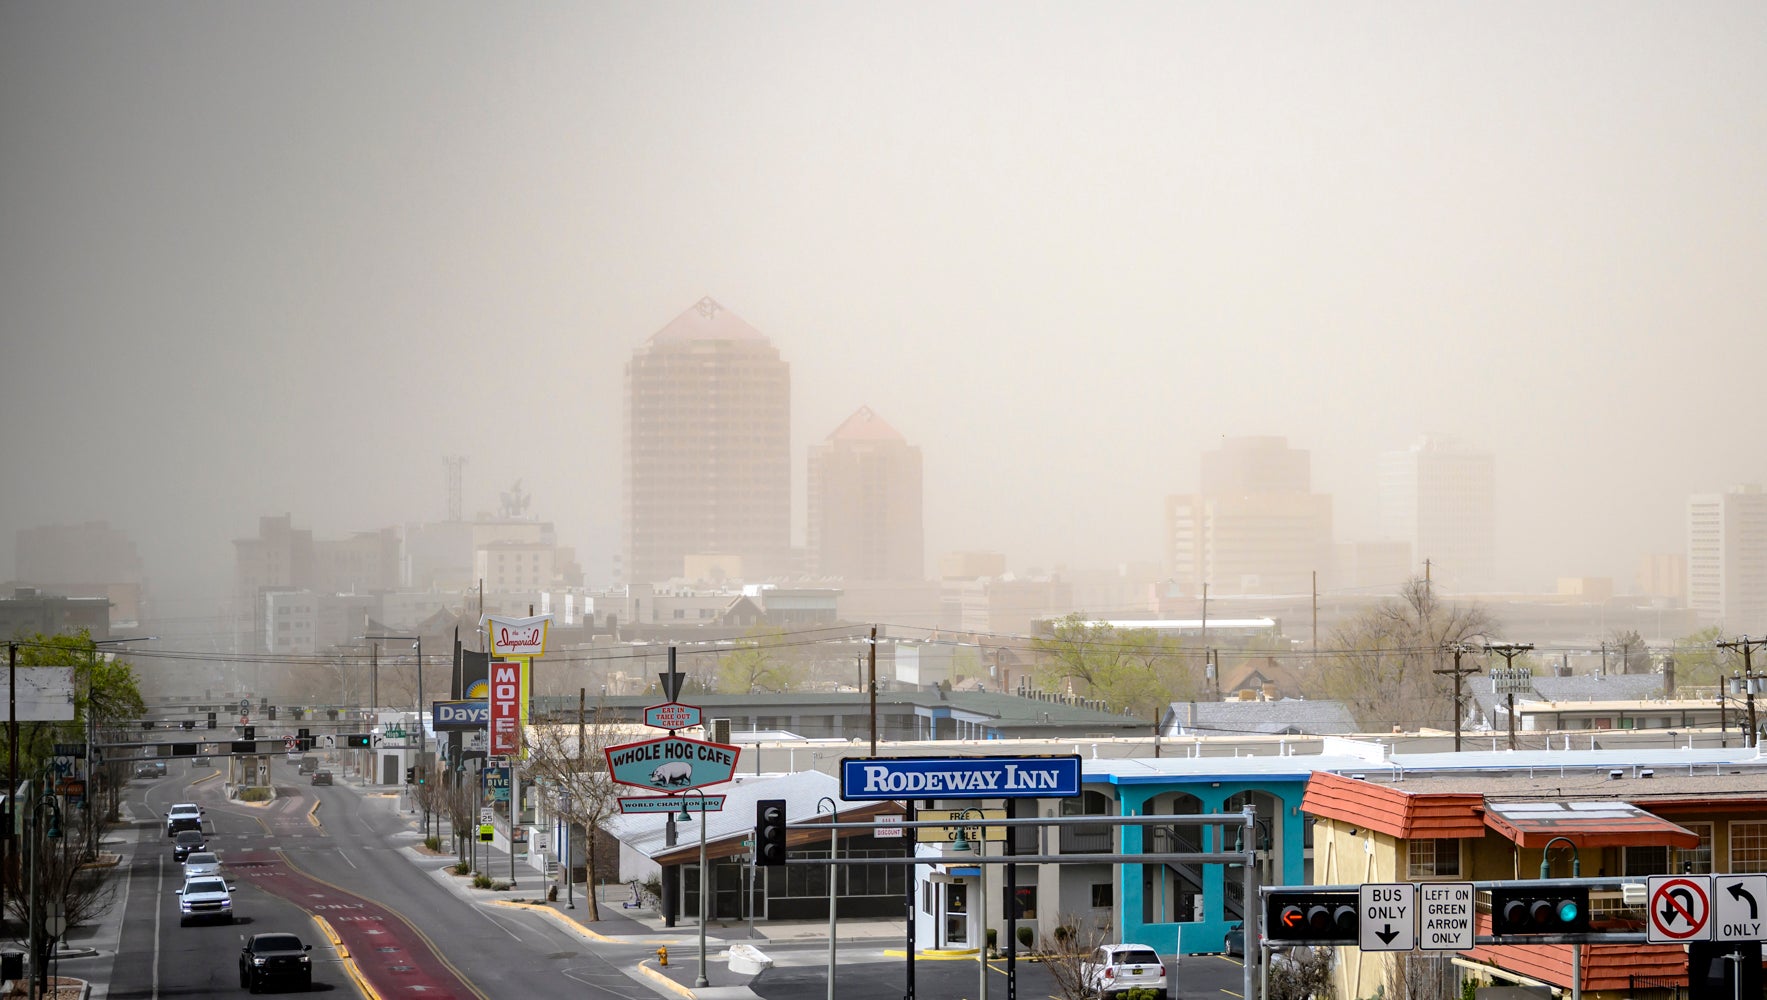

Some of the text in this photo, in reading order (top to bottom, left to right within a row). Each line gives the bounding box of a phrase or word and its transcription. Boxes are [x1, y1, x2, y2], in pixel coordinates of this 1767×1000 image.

[440, 706, 488, 722] Days
[495, 668, 515, 749] MOTEL
[613, 742, 731, 767] WHOLE HOG CAFE
[948, 831, 977, 841] CLE
[1373, 889, 1402, 902] BUS
[1425, 890, 1469, 901] LEFT ON
[1368, 906, 1406, 920] ONLY
[1428, 904, 1466, 915] GREEN
[1427, 919, 1468, 930] ARROW
[1723, 923, 1761, 937] ONLY
[1432, 933, 1461, 944] ONLY
